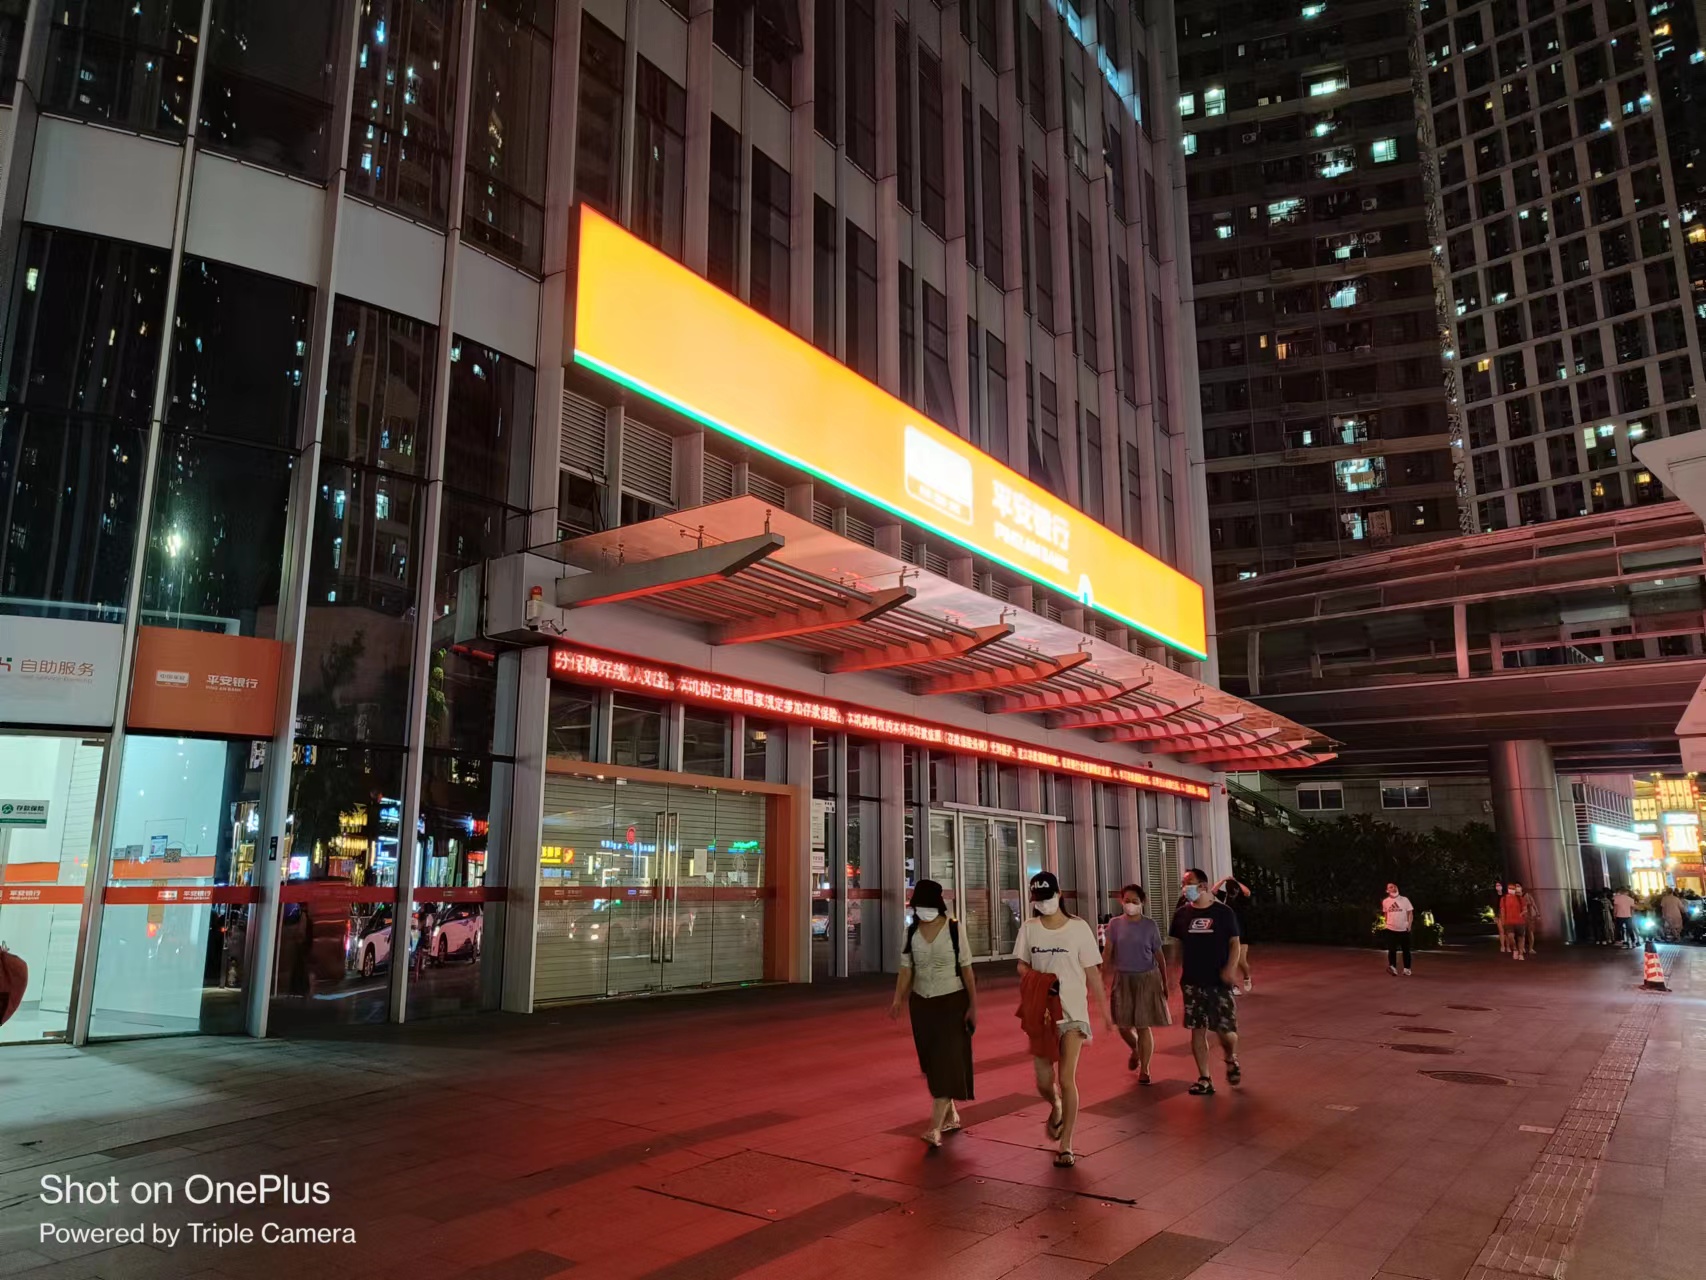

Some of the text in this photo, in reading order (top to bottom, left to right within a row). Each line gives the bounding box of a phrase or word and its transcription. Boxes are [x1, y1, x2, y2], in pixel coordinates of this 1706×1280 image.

[20, 659, 95, 677] 自助服务
[206, 674, 258, 688] 平安银行
[1031, 946, 1069, 955] Champion
